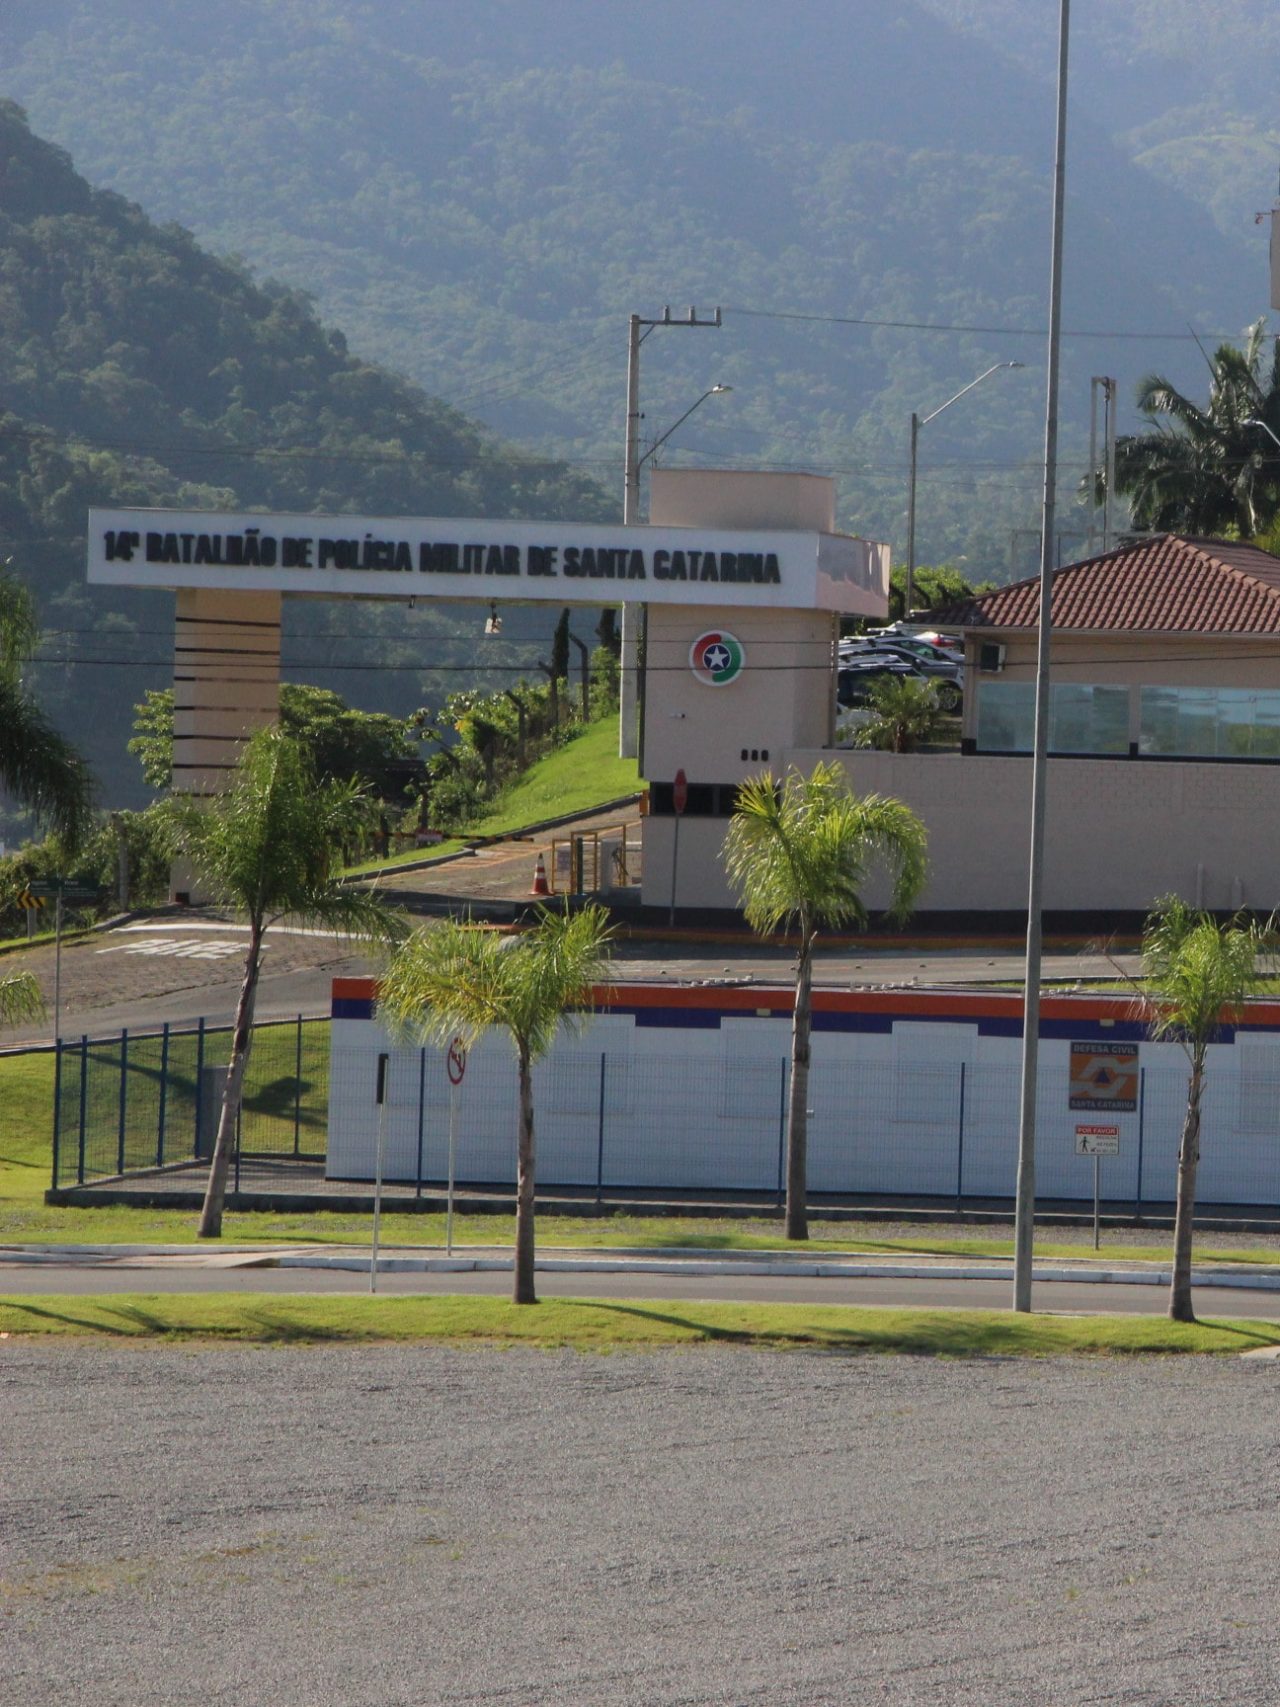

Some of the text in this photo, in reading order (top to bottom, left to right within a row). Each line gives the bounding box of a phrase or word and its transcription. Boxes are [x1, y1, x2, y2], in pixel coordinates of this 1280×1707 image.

[146, 528, 277, 567] BATALHÃO
[282, 538, 313, 568] DE
[318, 533, 413, 571] POLÍCIA
[419, 542, 520, 575] MILITAR
[526, 545, 558, 577] DE
[563, 547, 646, 580] SANTA
[652, 549, 781, 584] CATARINA
[1074, 1044, 1137, 1055] DEFESA CIVIL
